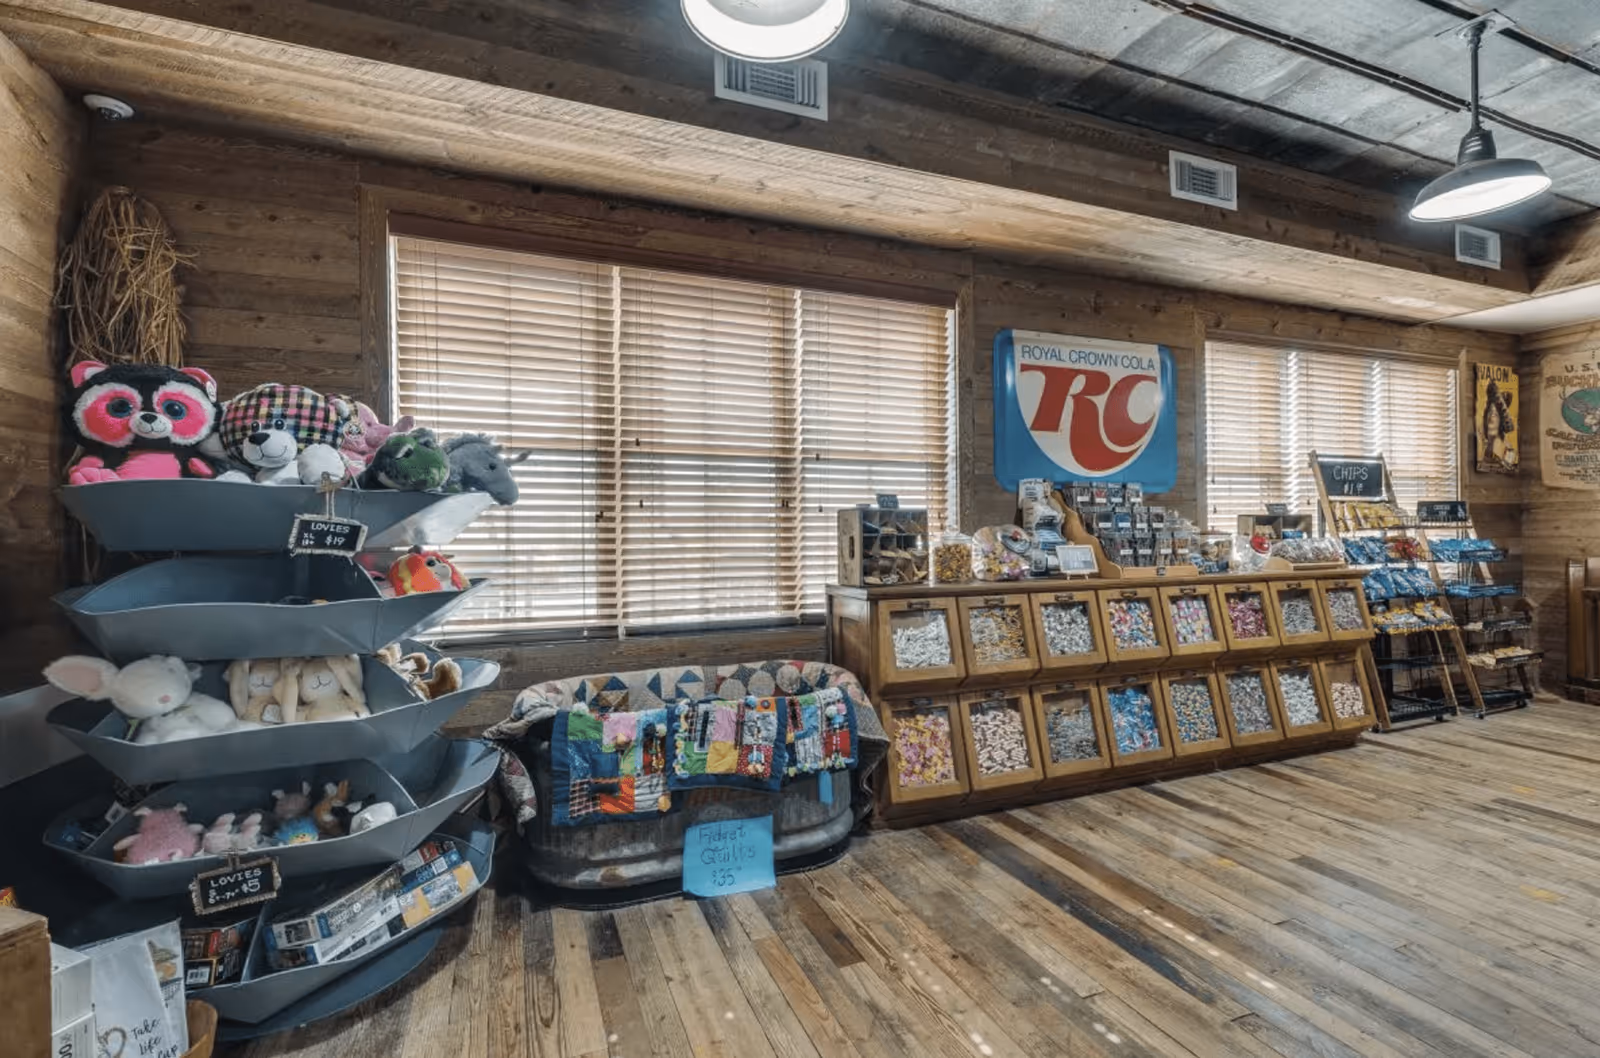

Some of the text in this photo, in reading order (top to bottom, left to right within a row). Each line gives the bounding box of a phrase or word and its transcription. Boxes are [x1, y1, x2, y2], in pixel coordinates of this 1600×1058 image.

[1021, 345, 1155, 371] ROYAL CROWN COLA
[1020, 363, 1158, 472] RC
[1333, 465, 1369, 480] CHIPS
[311, 522, 350, 534] LOVIES
[324, 534, 346, 546] $19
[210, 868, 262, 888] LOVIES
[241, 879, 261, 894] $5
